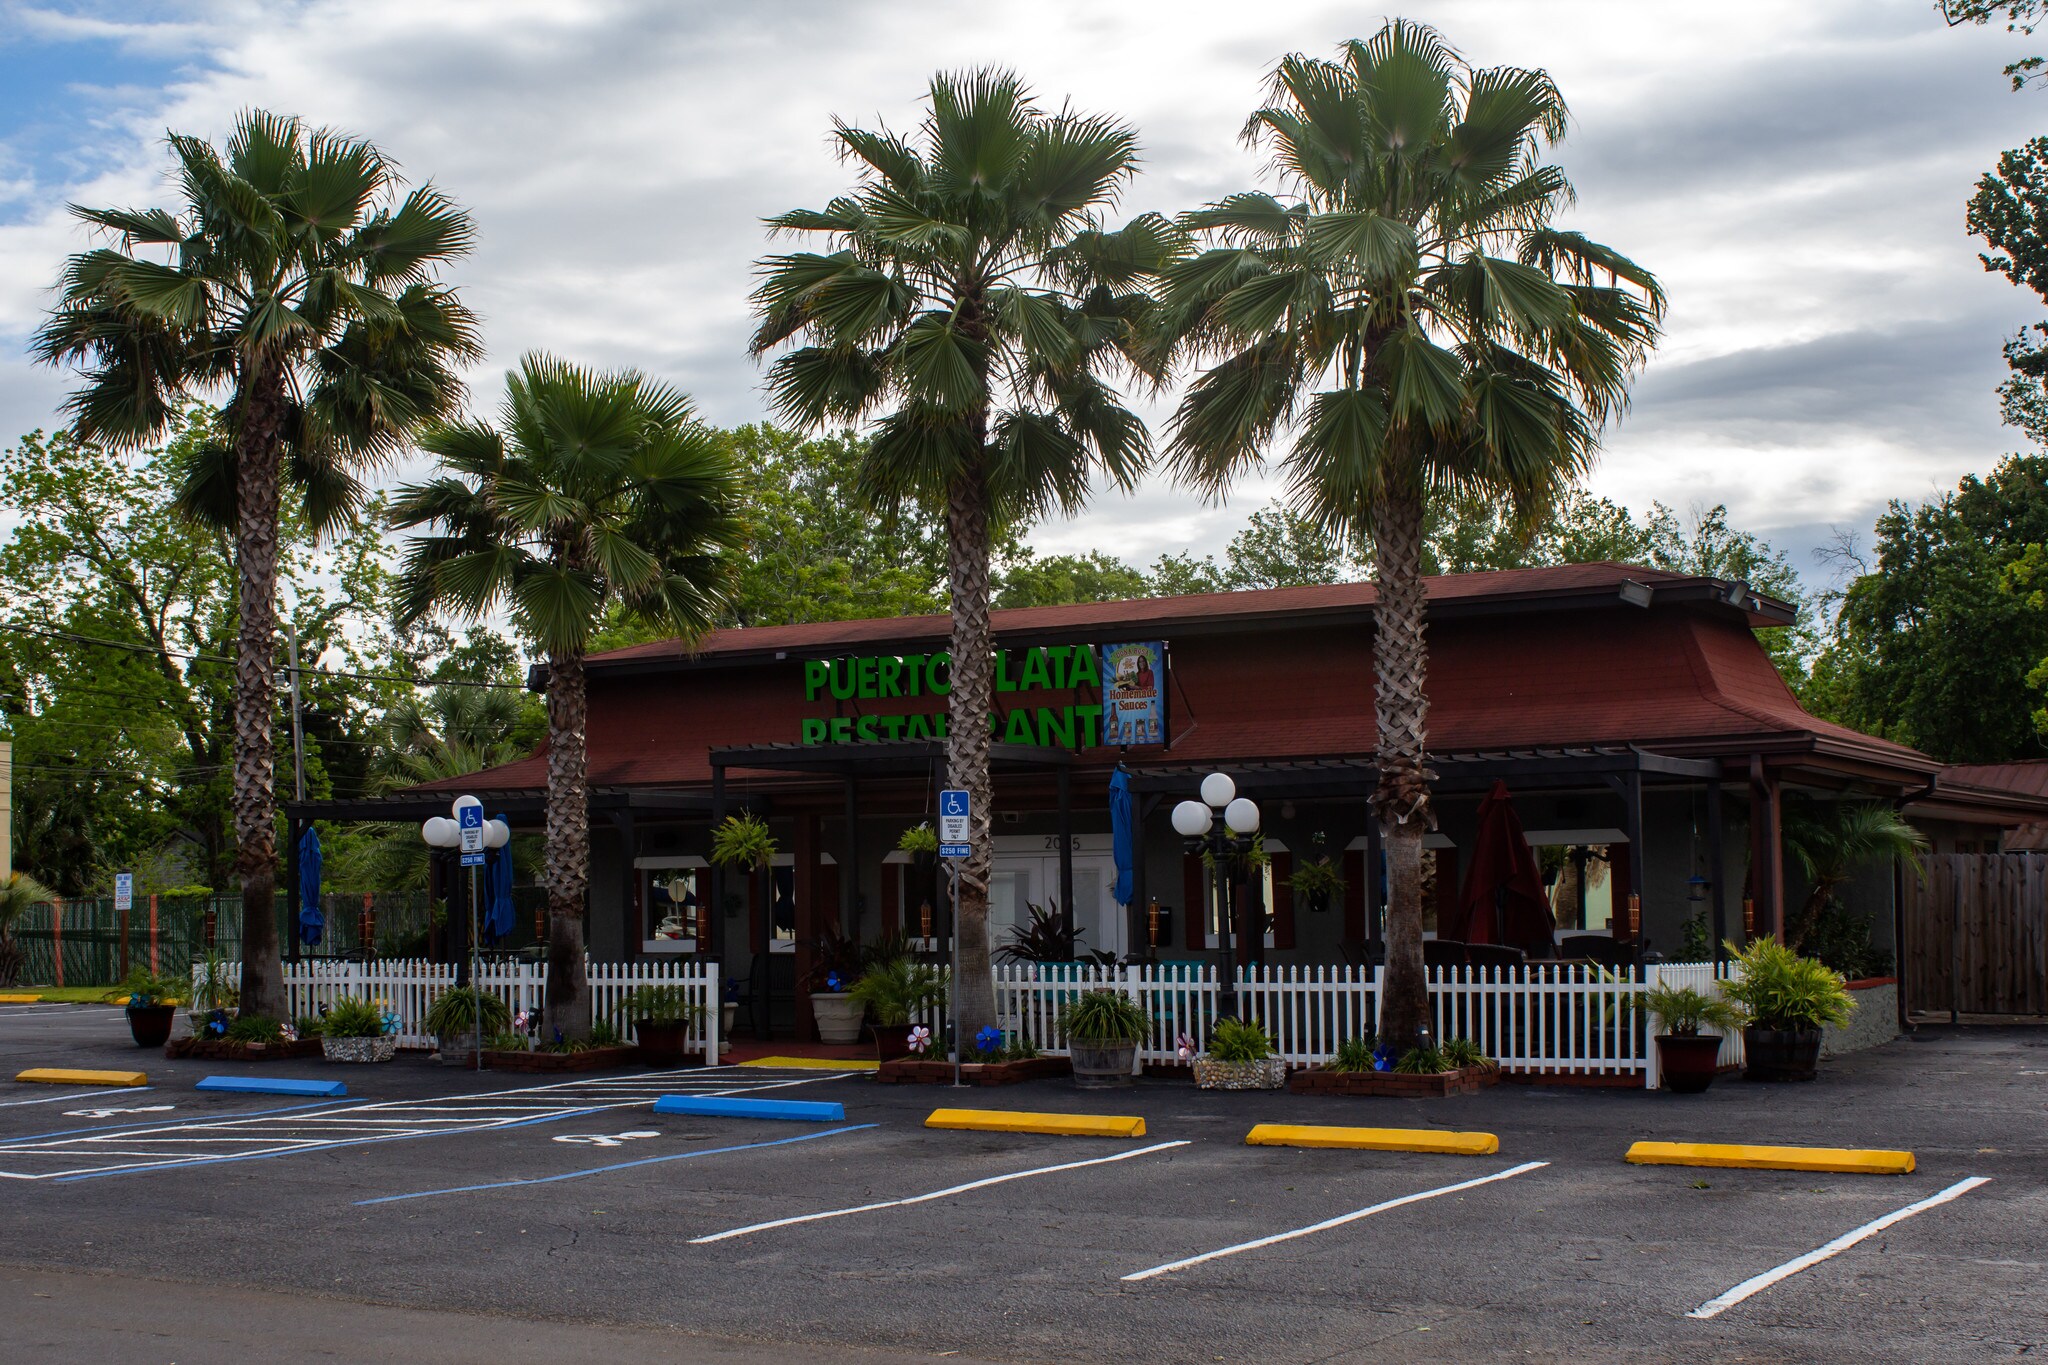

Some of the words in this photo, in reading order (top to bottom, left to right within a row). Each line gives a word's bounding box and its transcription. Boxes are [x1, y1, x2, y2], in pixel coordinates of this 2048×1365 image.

[805, 652, 953, 701] PUERTO
[996, 644, 1101, 692] LATA
[1110, 686, 1157, 700] Homemade
[1118, 700, 1148, 711] Sauces
[1044, 836, 1081, 851] 205
